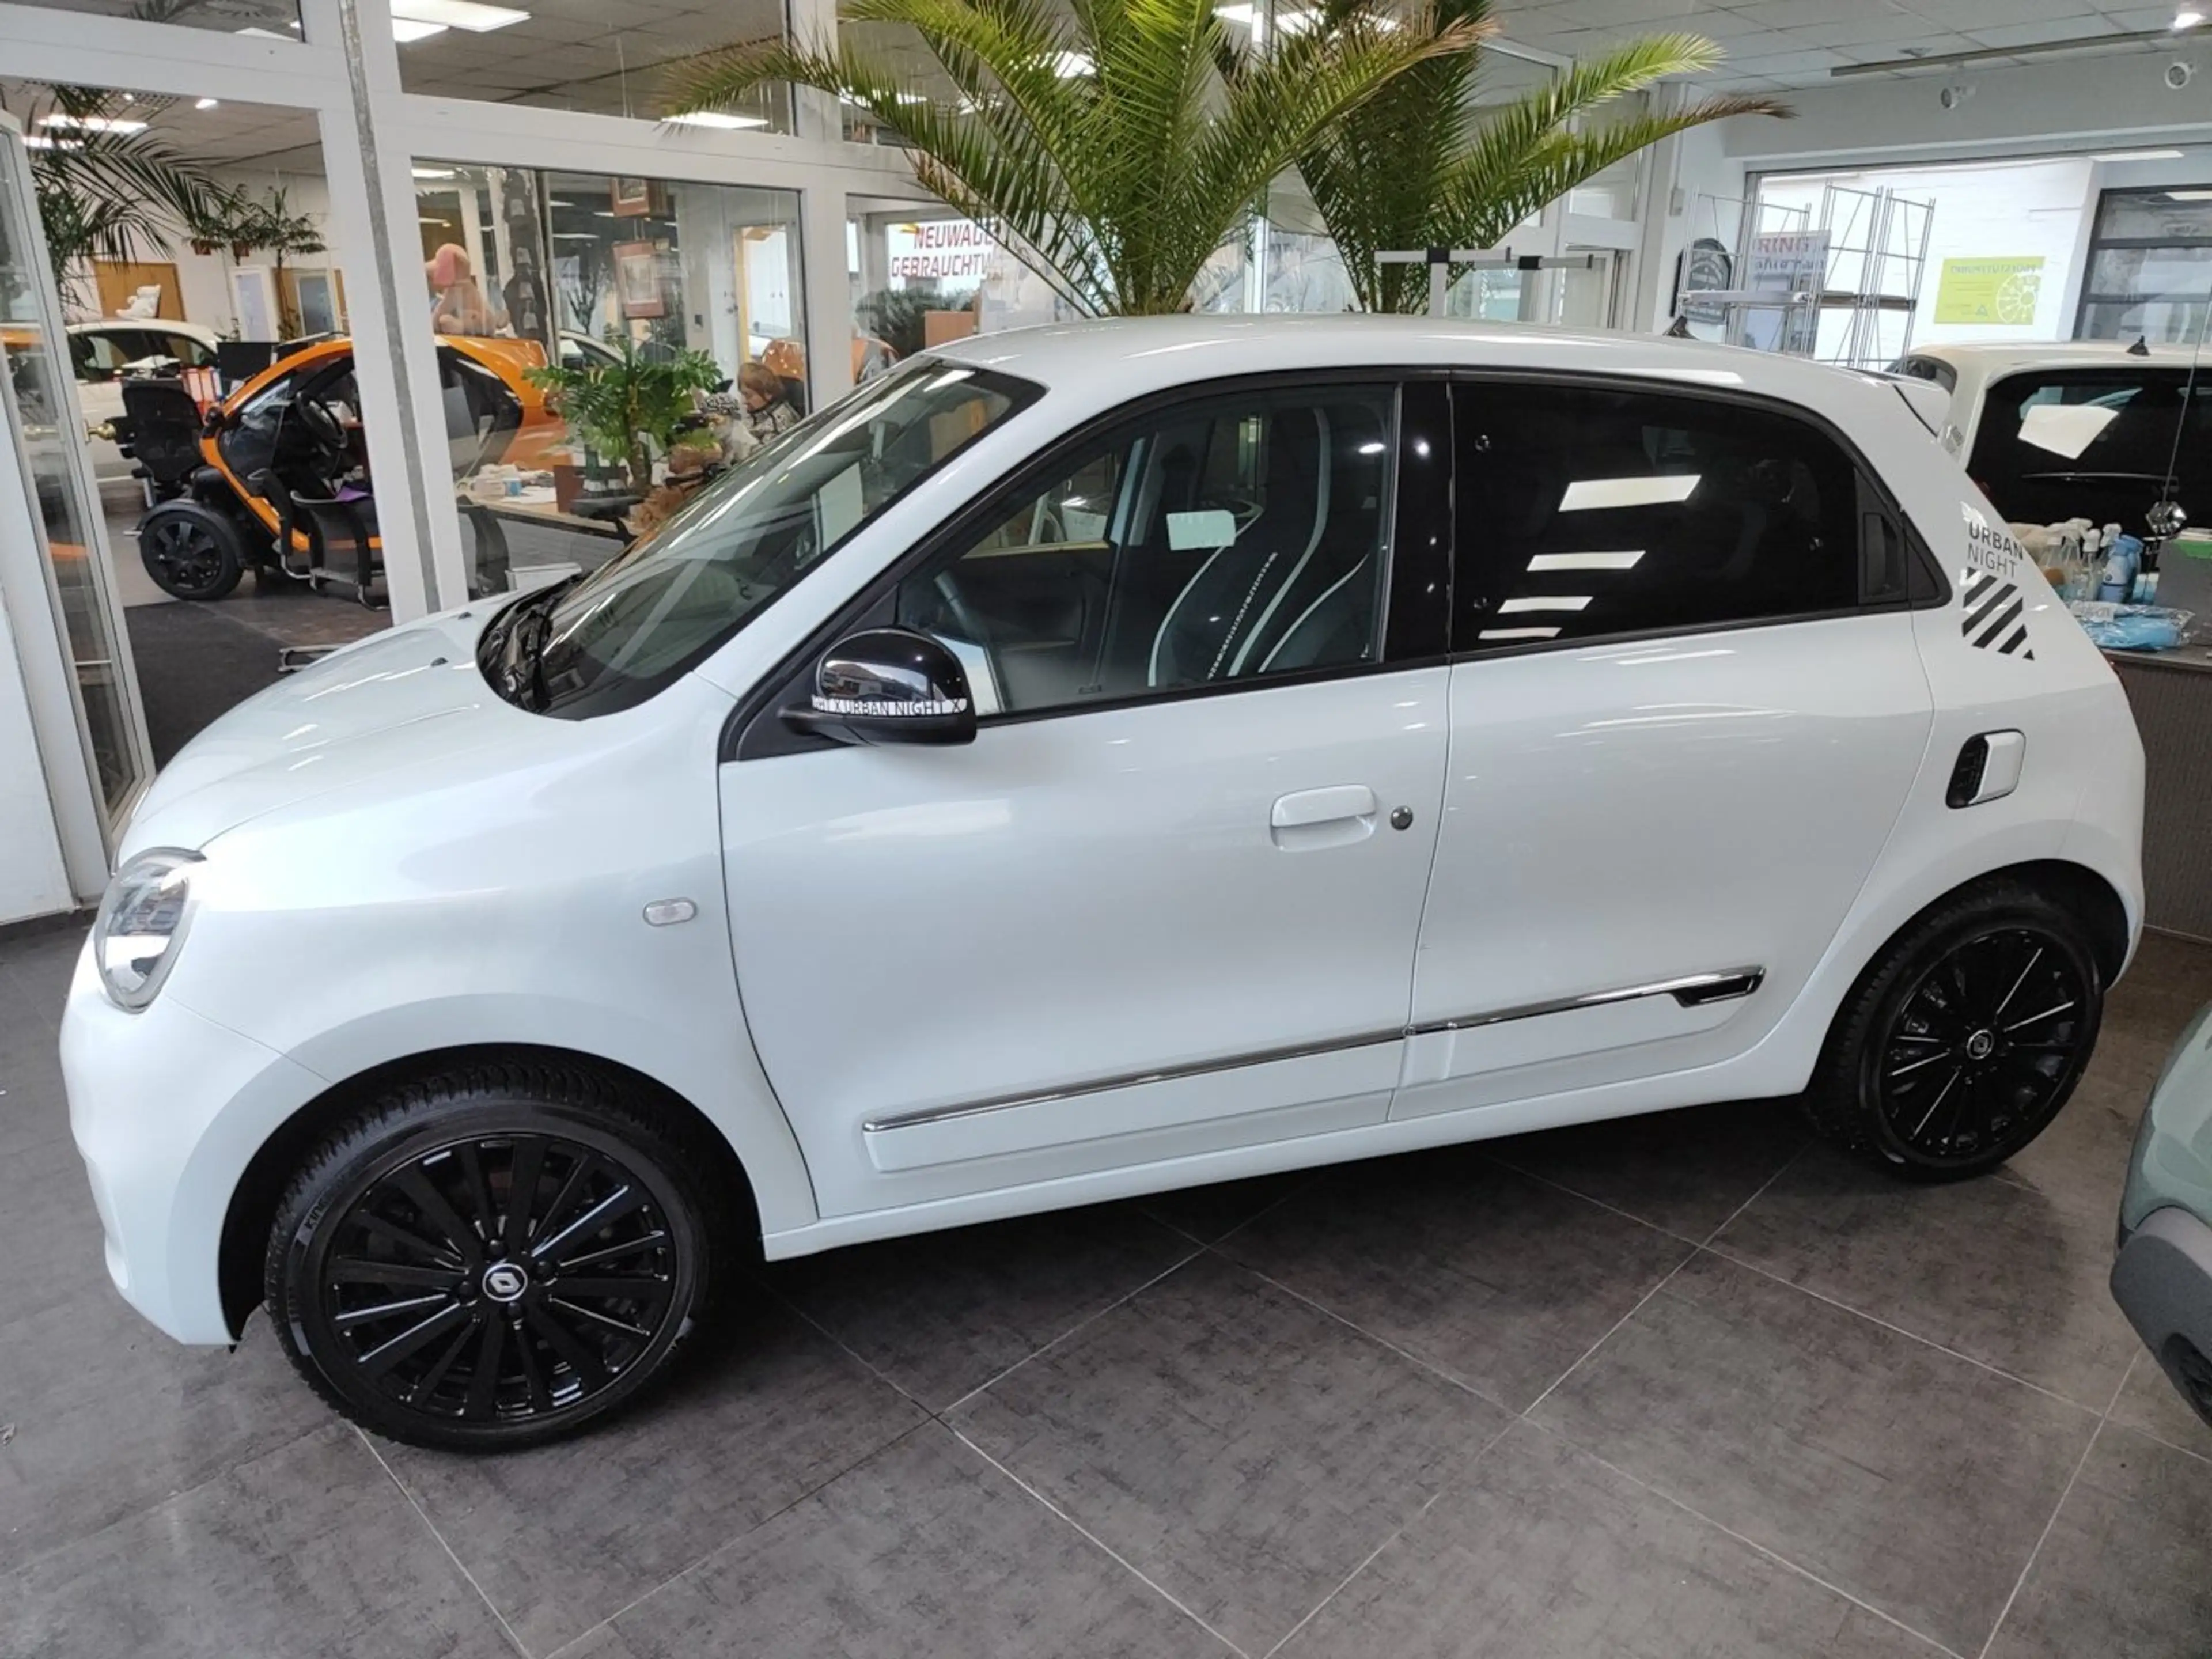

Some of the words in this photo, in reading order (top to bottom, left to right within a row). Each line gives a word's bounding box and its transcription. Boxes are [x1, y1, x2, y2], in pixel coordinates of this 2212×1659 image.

[1969, 521, 2024, 560] URBAN
[1968, 543, 2017, 578] NIGHT
[844, 699, 889, 715] URBAN
[895, 700, 947, 716] NIGHT
